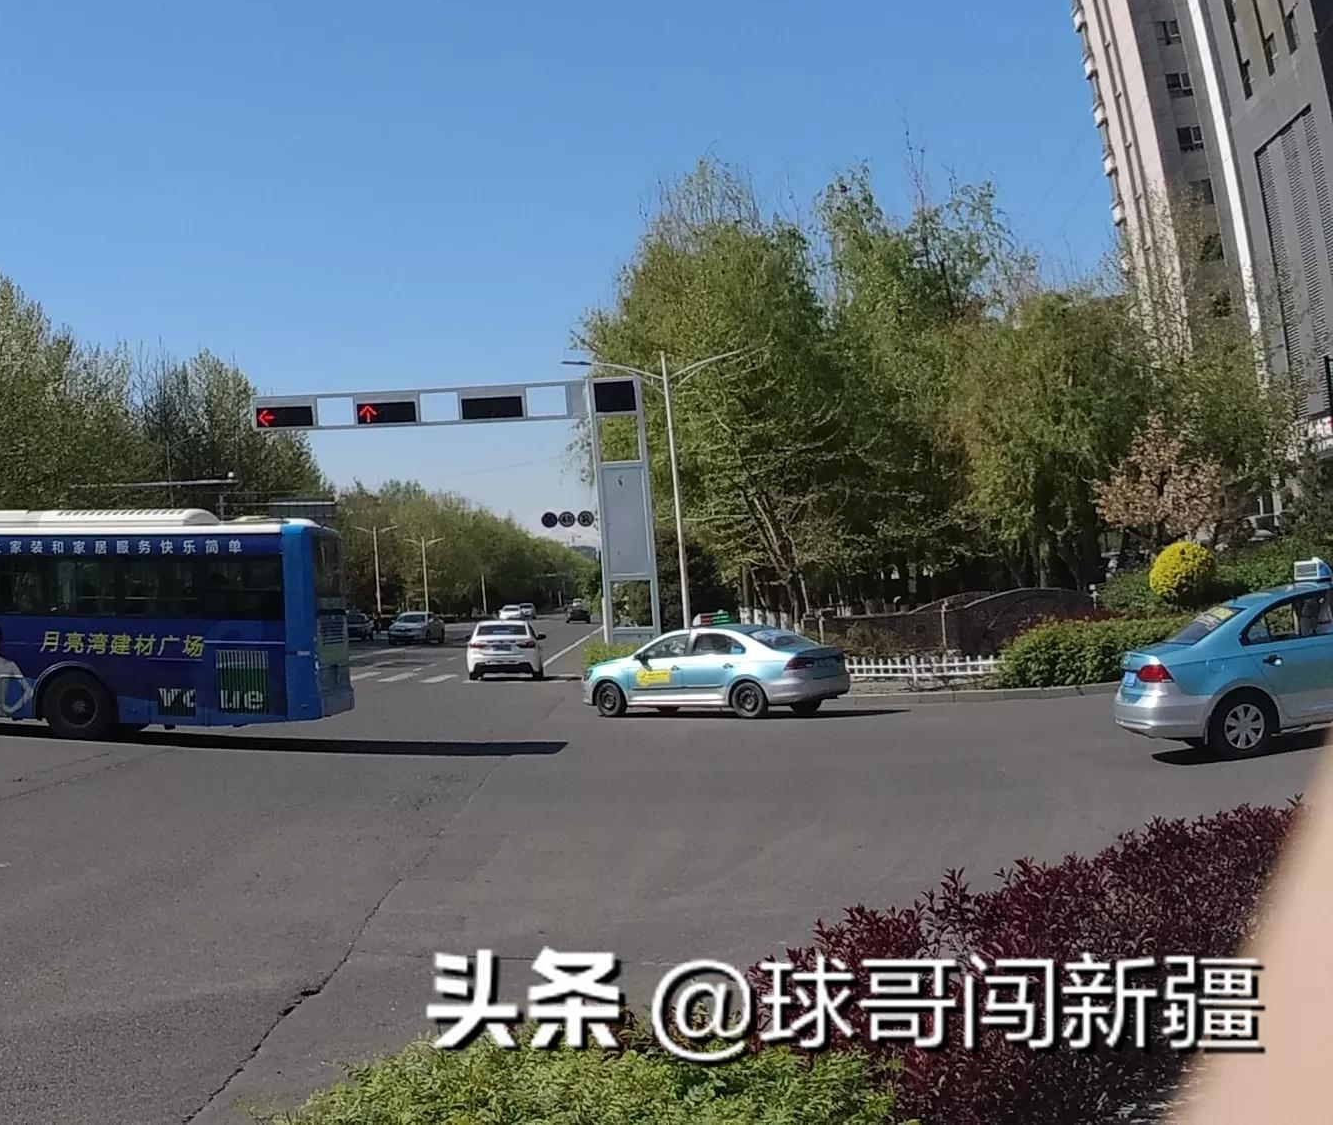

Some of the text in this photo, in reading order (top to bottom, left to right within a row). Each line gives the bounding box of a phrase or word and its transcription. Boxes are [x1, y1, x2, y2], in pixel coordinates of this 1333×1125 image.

[39, 630, 206, 658] 月亮湾建材广场
